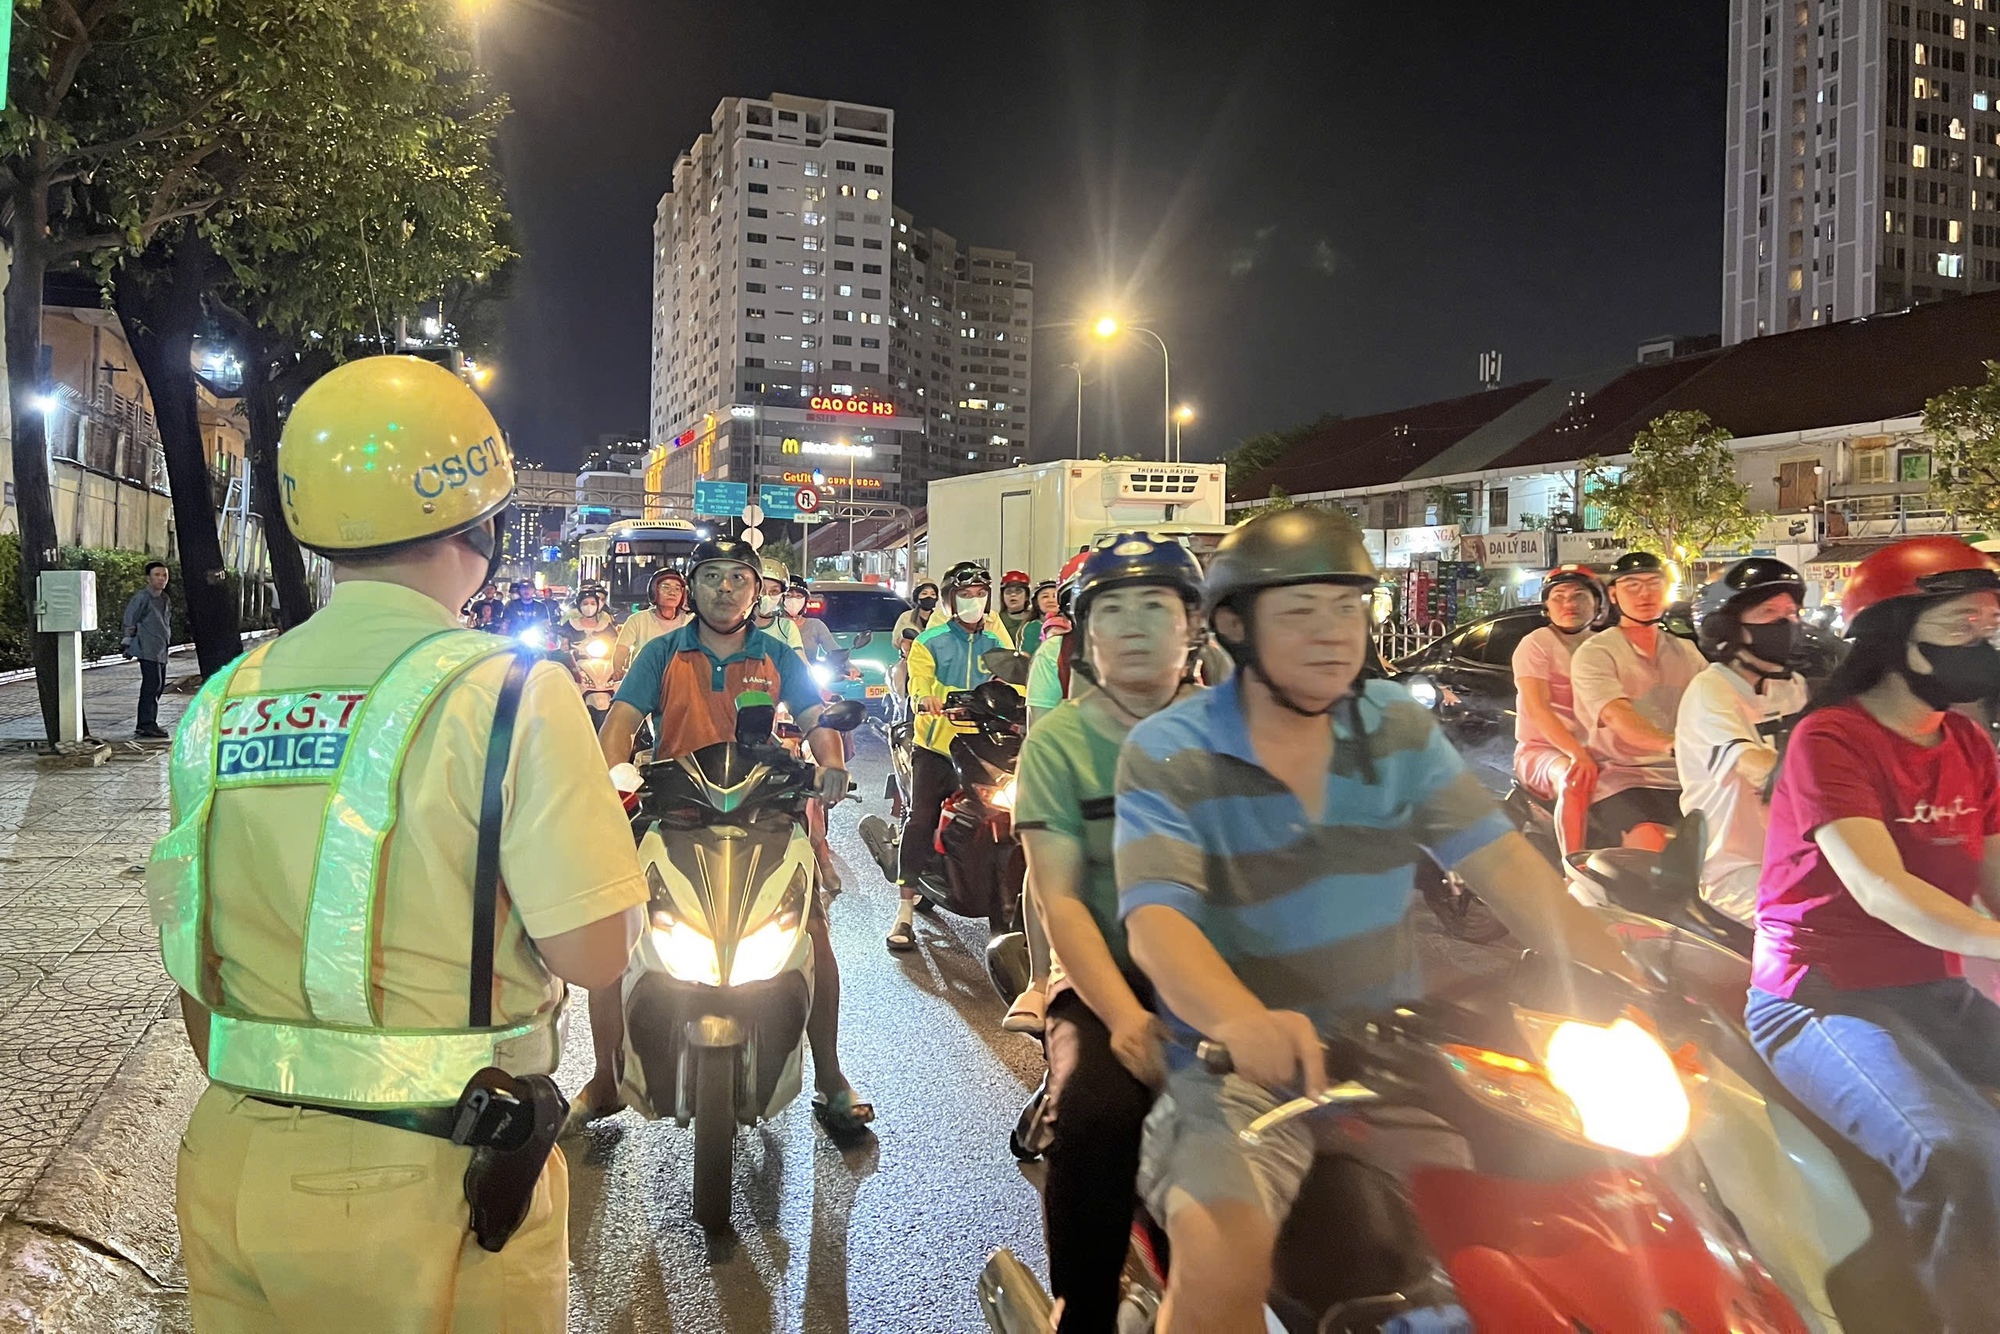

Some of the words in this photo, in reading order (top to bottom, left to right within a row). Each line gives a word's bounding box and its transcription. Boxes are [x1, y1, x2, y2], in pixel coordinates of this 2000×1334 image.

[810, 397, 843, 411] CAO
[846, 395, 868, 413] ỐC
[872, 401, 893, 415] H3
[414, 435, 500, 498] CSGT
[618, 543, 627, 552] 31
[1489, 541, 1506, 558] ĐẠI
[1508, 537, 1519, 554] LÝ
[1521, 540, 1537, 553] BIA
[220, 736, 338, 772] POLICE
